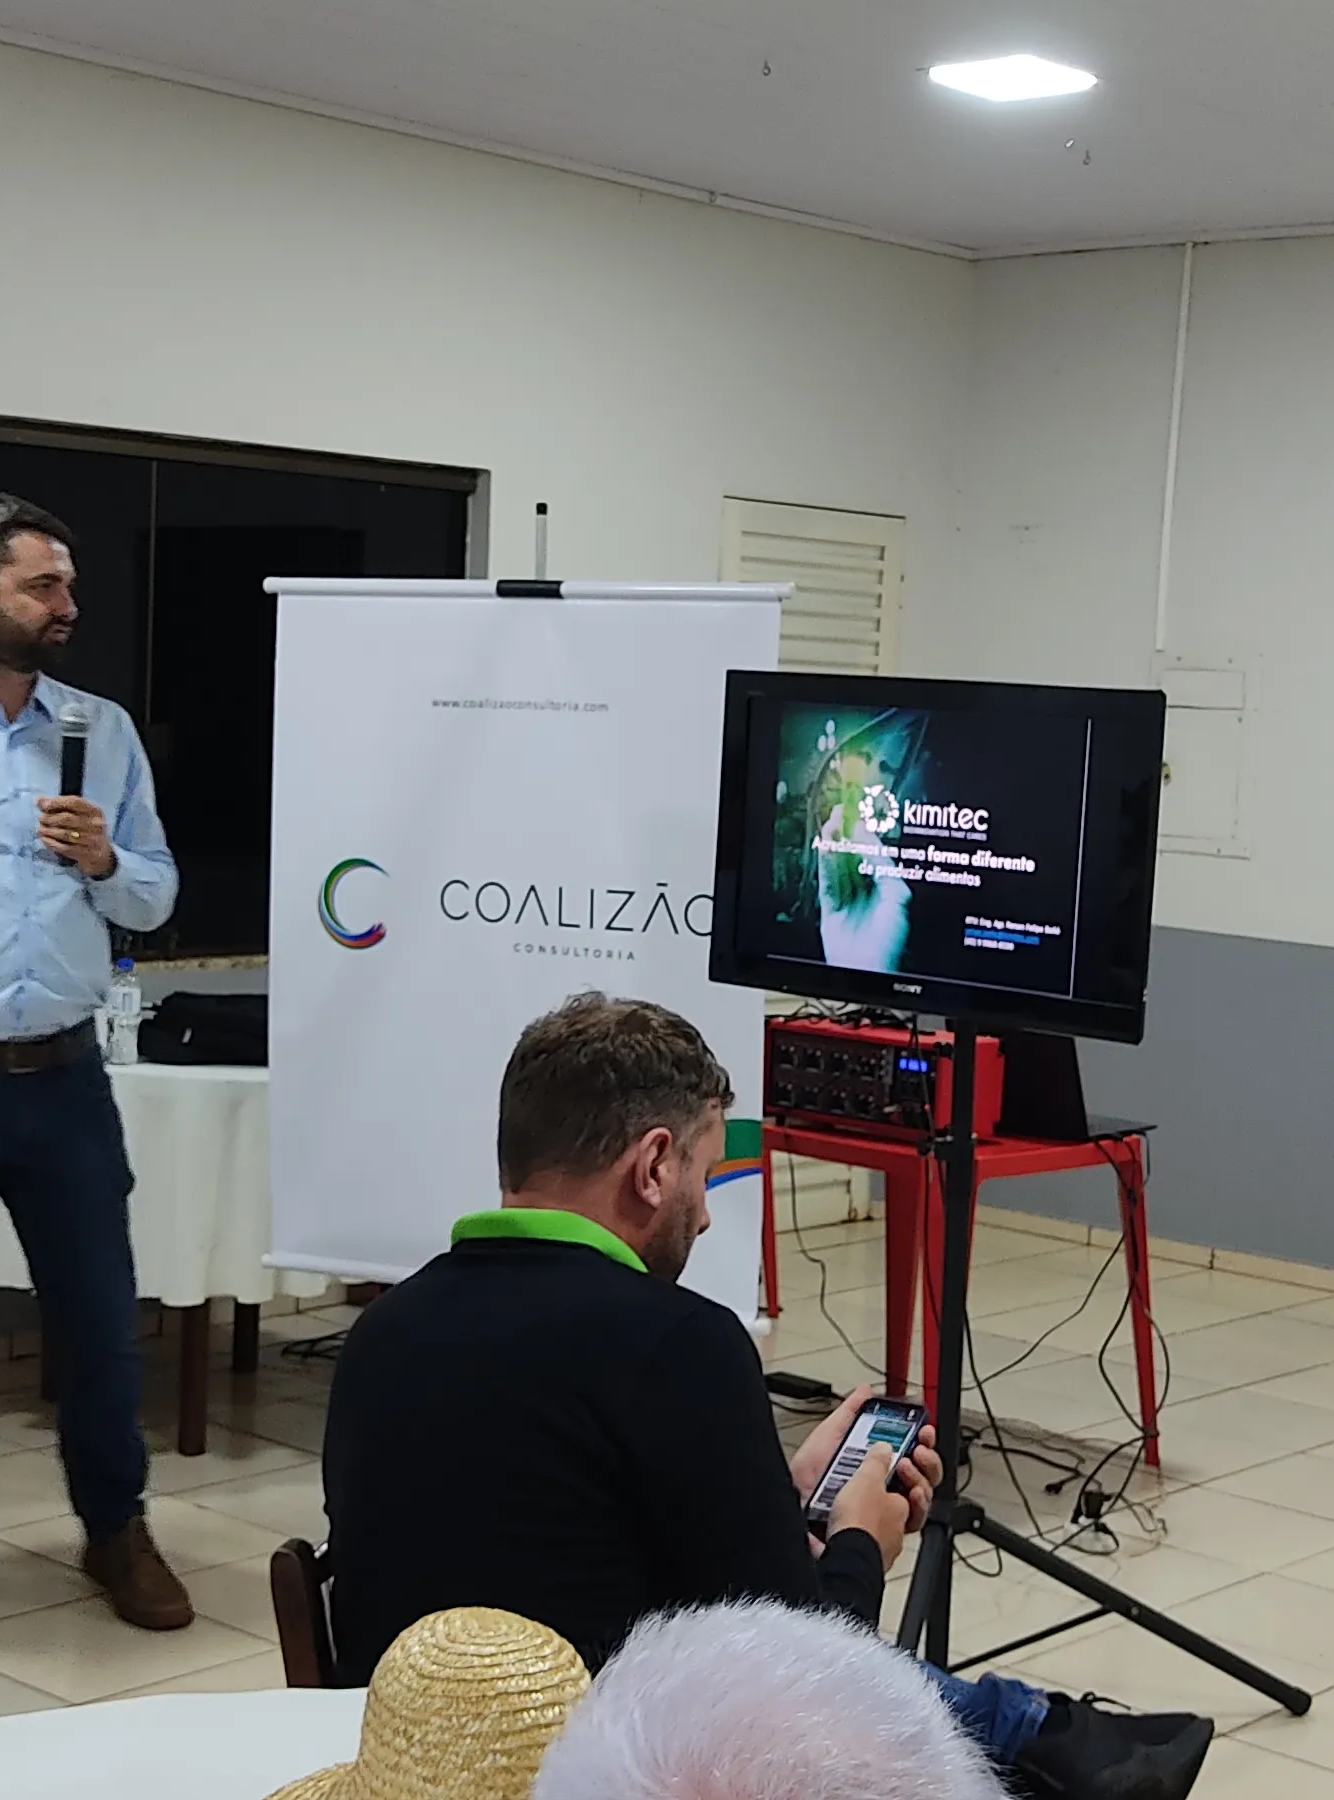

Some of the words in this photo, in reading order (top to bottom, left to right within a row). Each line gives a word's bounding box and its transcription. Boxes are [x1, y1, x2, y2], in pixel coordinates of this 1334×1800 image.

[903, 799, 990, 831] kimitec
[858, 858, 874, 875] de
[925, 865, 981, 887] alimentos
[927, 844, 970, 866] forma
[971, 849, 1036, 873] diferente
[512, 942, 636, 961] CONSULTORIA
